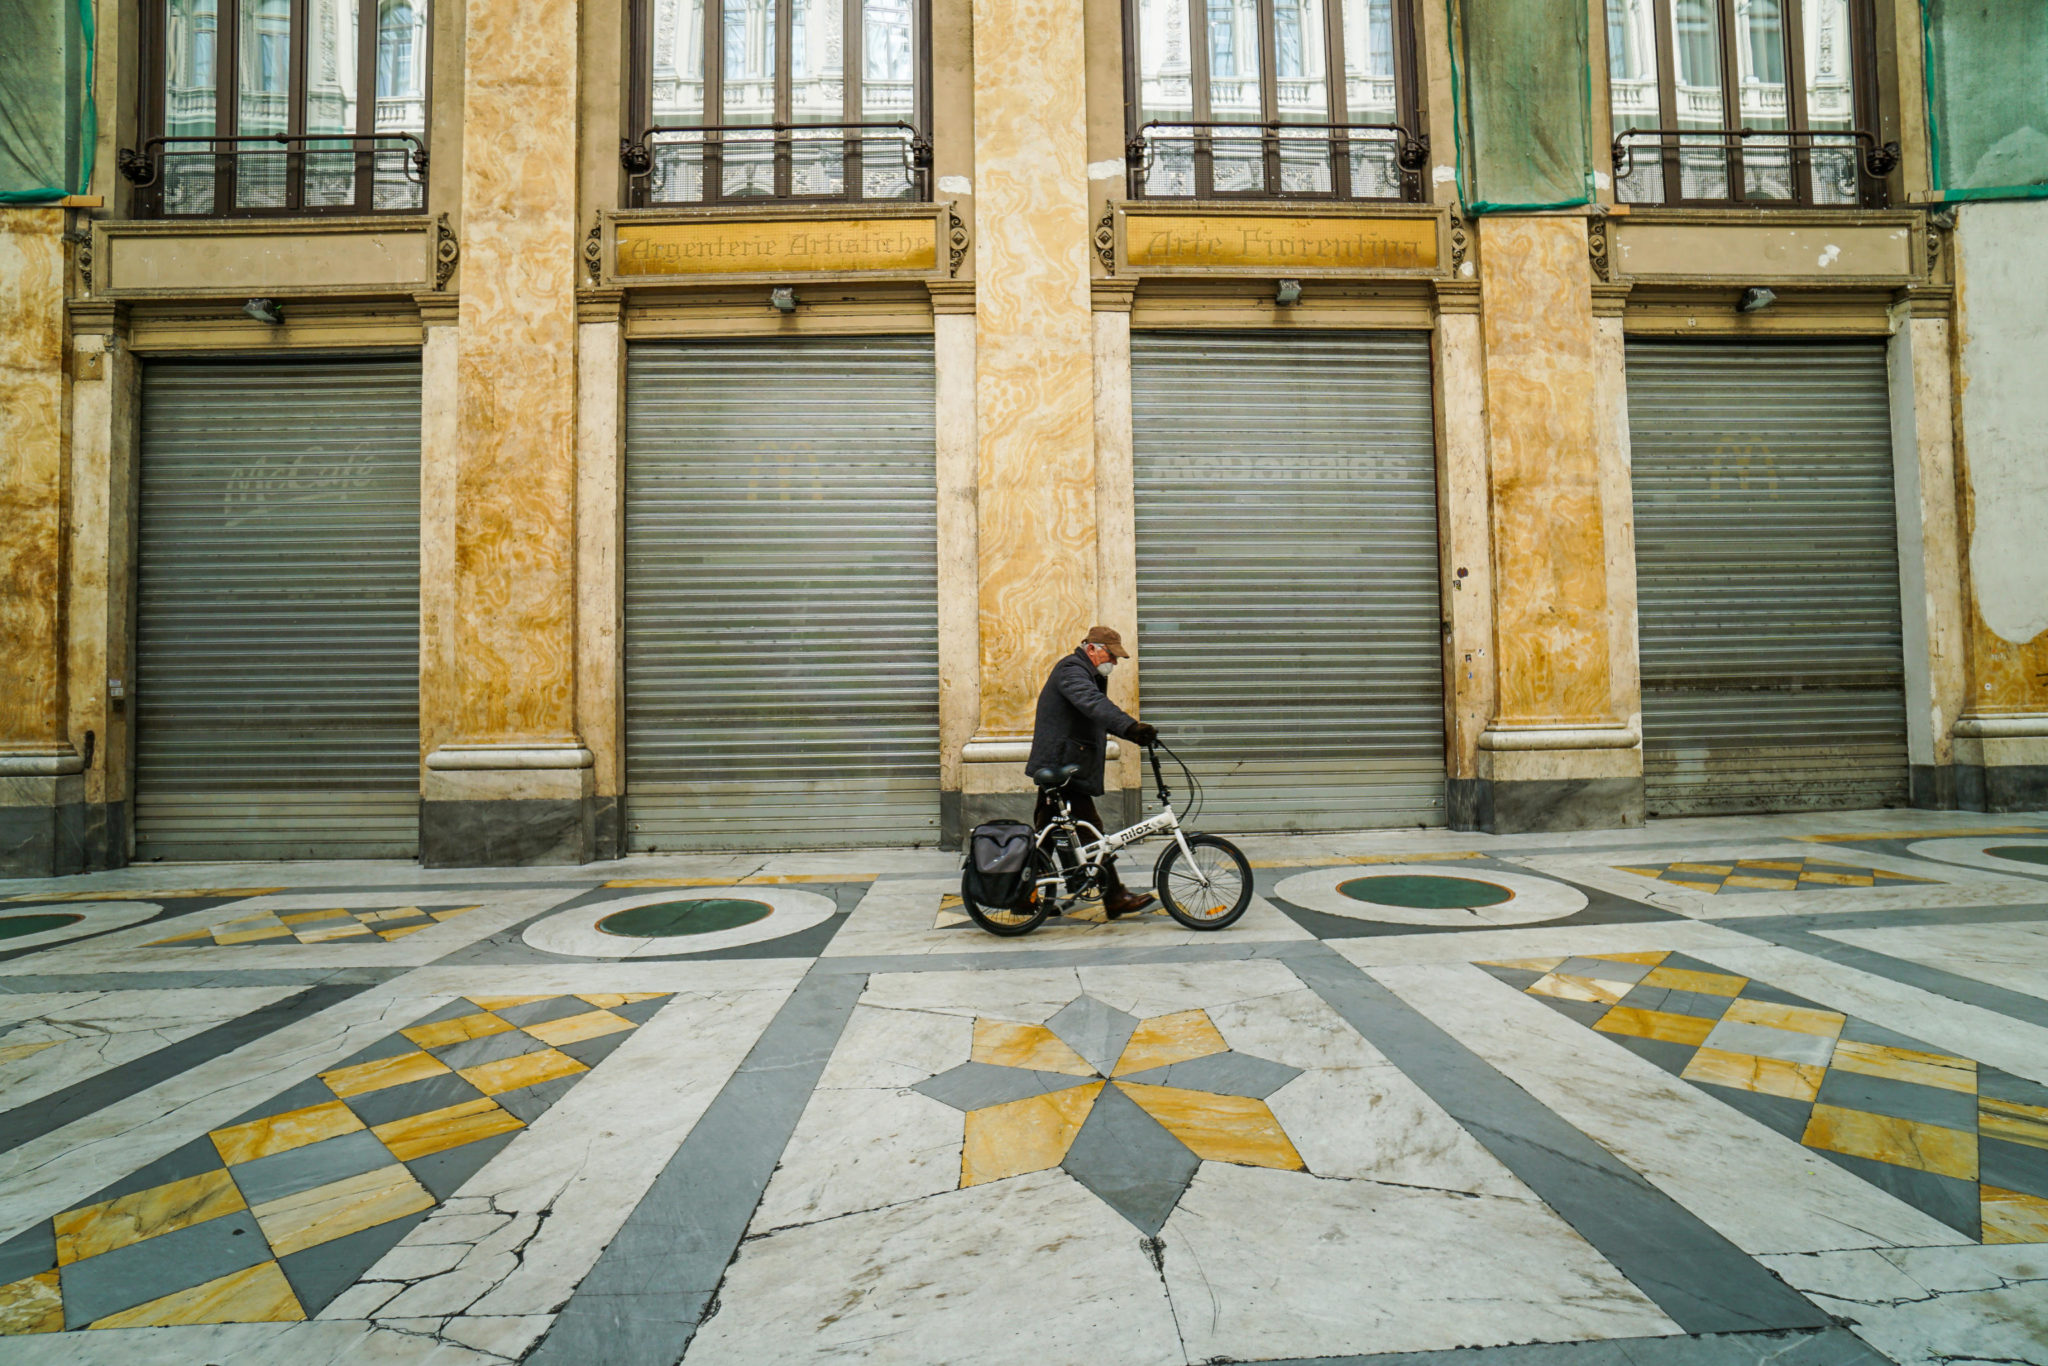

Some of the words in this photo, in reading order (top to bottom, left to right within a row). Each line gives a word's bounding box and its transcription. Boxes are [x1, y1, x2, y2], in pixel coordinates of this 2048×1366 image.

[631, 235, 776, 263] Argenterie
[785, 230, 929, 257] Artistiche
[1146, 230, 1223, 257] Arte
[1237, 227, 1421, 258] Fiorentina
[1120, 822, 1152, 842] nilox
